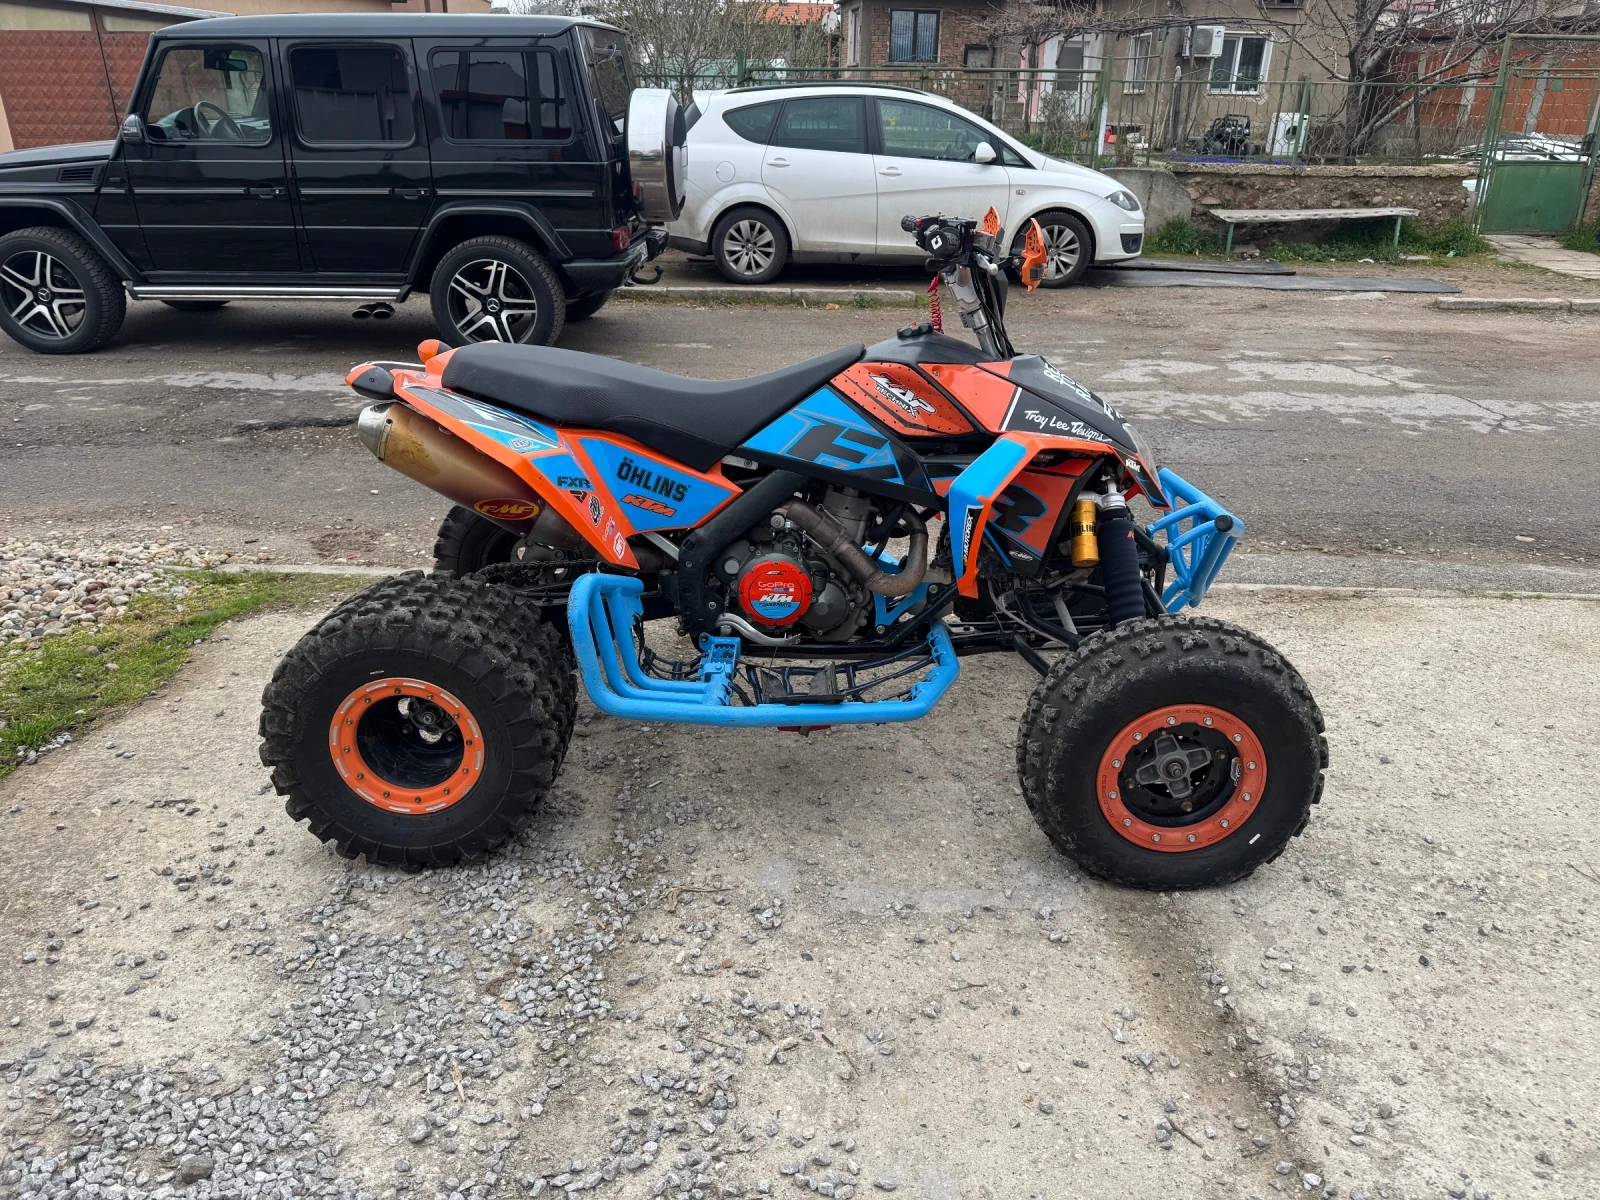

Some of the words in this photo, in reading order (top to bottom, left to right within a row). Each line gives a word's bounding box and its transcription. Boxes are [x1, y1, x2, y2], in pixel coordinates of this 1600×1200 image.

[1024, 410, 1048, 429] Troy
[1049, 415, 1070, 431] Lee
[1071, 421, 1113, 442] Designs
[556, 476, 591, 488] FXR
[617, 456, 688, 502] ÖHLINS
[479, 503, 535, 514] FMF
[620, 494, 677, 518] KTM
[963, 513, 974, 556] MOTOREX
[760, 593, 794, 603] KTM
